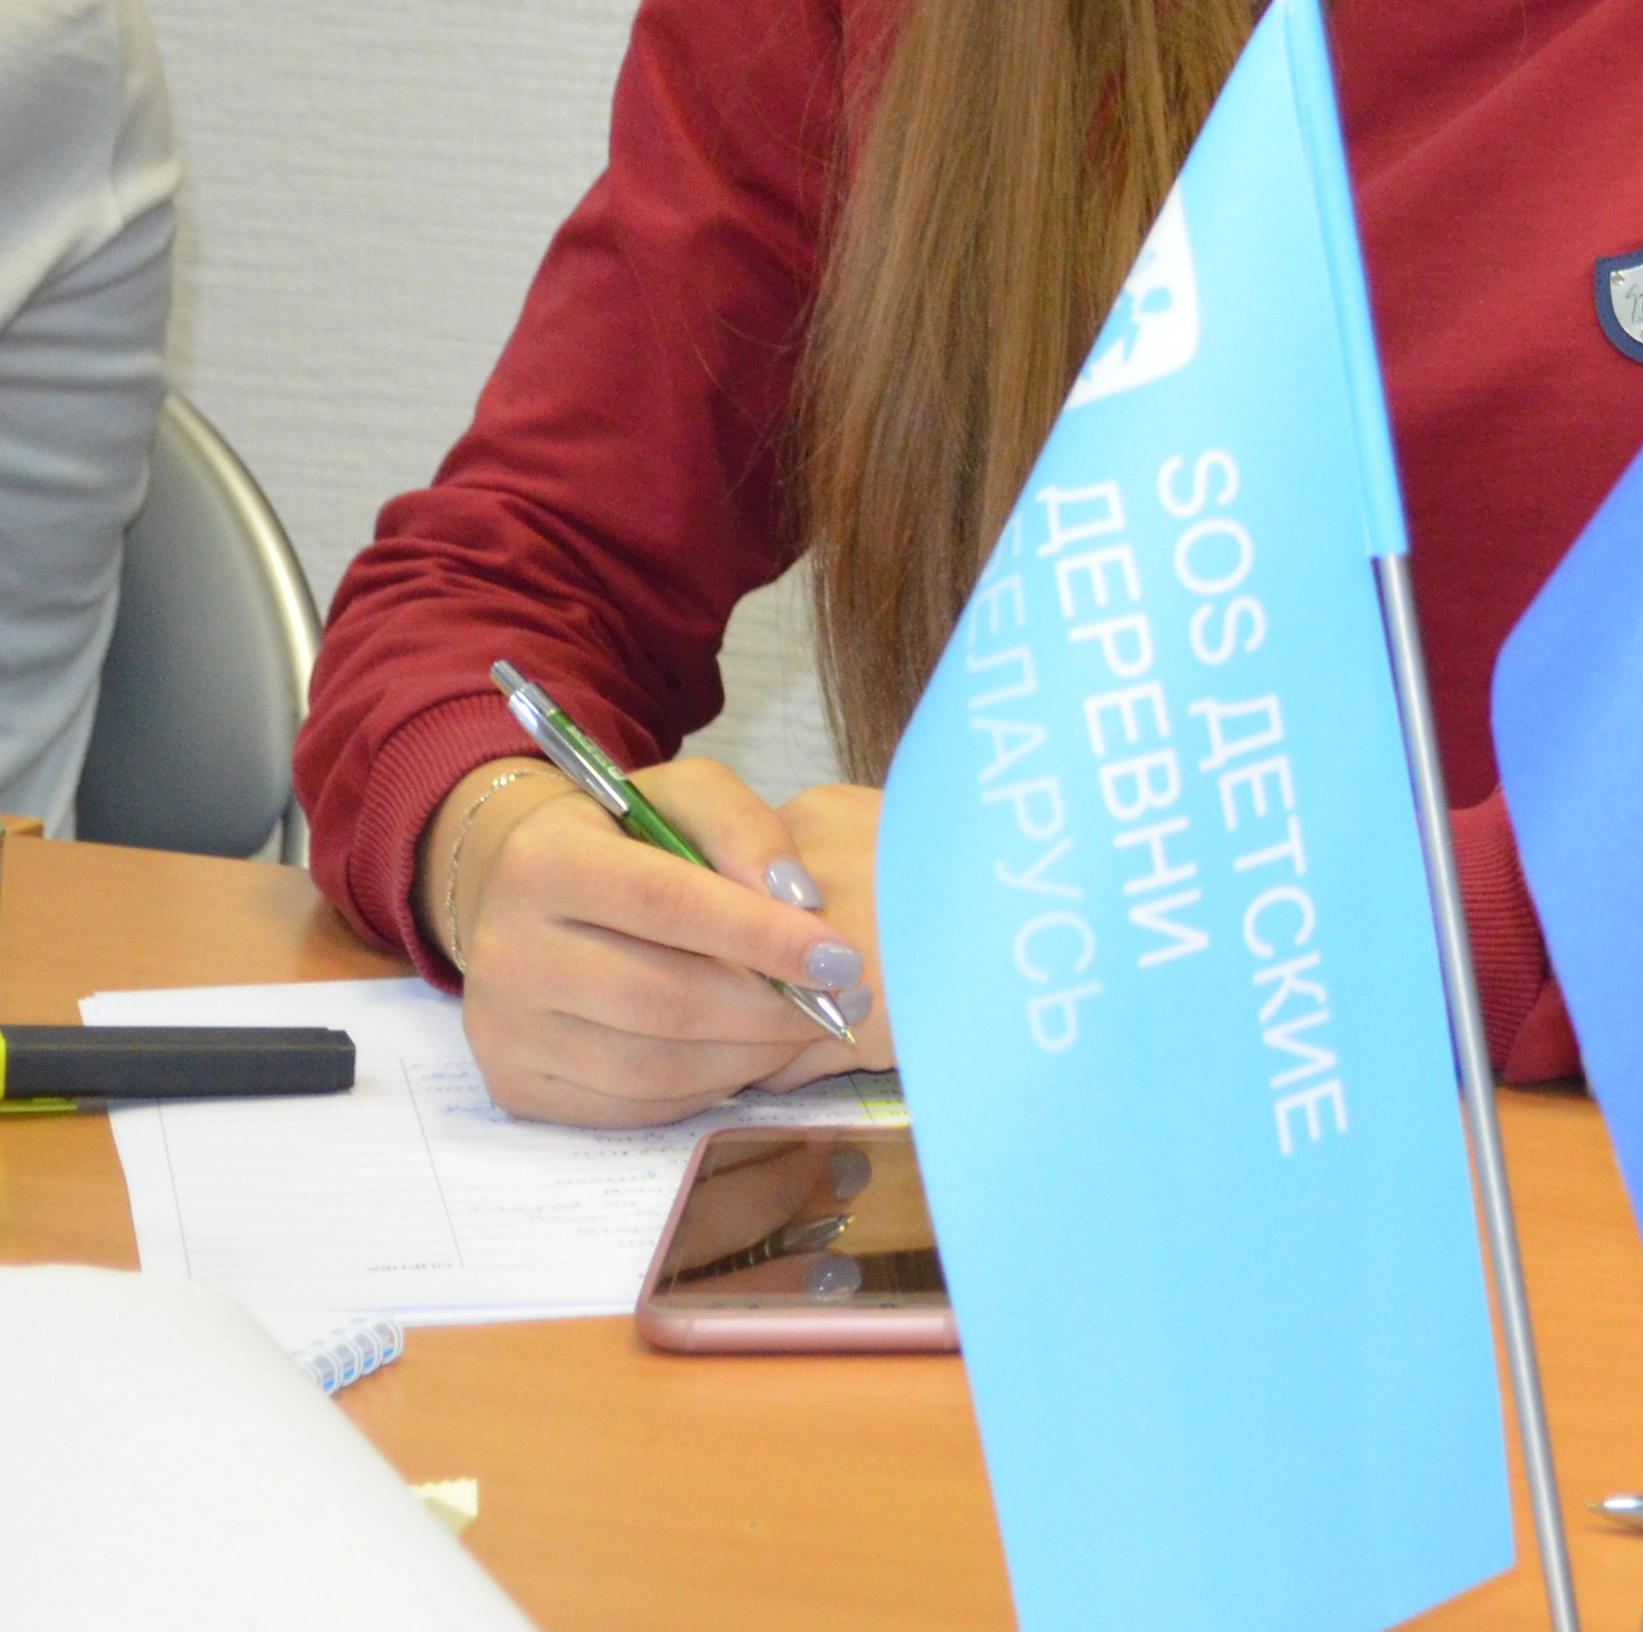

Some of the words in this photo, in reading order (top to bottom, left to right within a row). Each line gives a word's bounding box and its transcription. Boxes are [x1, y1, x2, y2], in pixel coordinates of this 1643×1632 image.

[1034, 479, 1210, 969] ДЕРЕВНИ
[1156, 449, 1266, 666] SOS
[1188, 692, 1348, 1156] ДЕТСКИЕ
